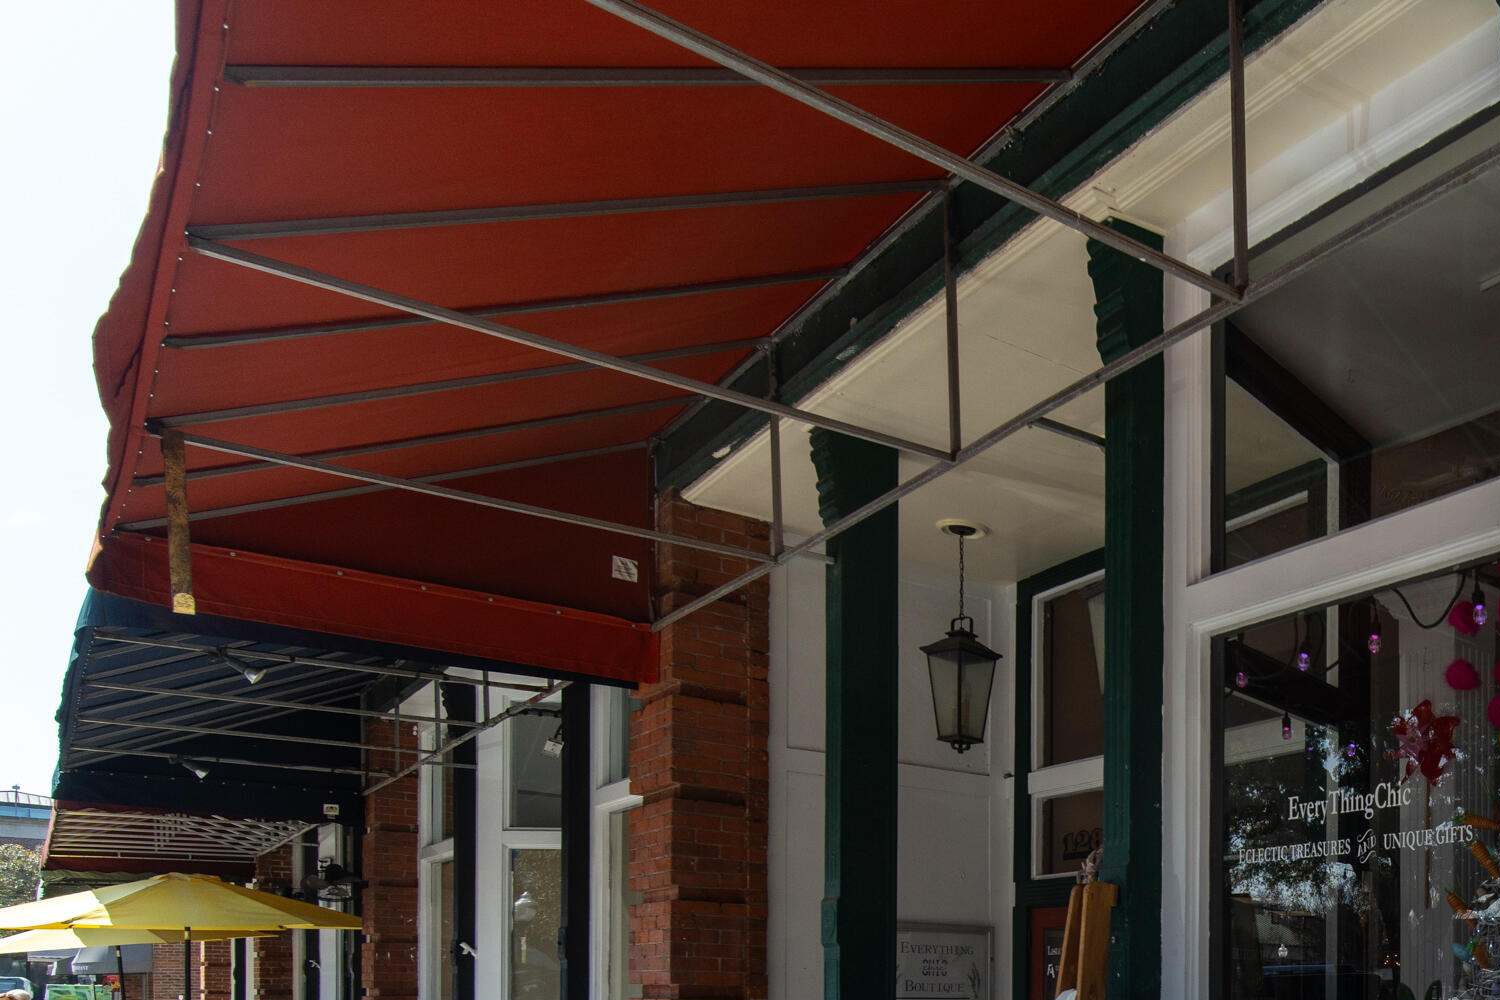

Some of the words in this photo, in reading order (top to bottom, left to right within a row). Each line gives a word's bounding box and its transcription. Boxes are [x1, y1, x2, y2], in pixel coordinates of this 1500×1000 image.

[1287, 781, 1412, 826] EveryThingChic
[1238, 845, 1288, 866] ECLECTIC
[1290, 838, 1351, 858] TREASURES
[1357, 831, 1378, 860] AND
[1383, 827, 1434, 851] UNIQUE
[1436, 823, 1474, 846] GIFTS
[905, 979, 965, 993] BOUTIQUE
